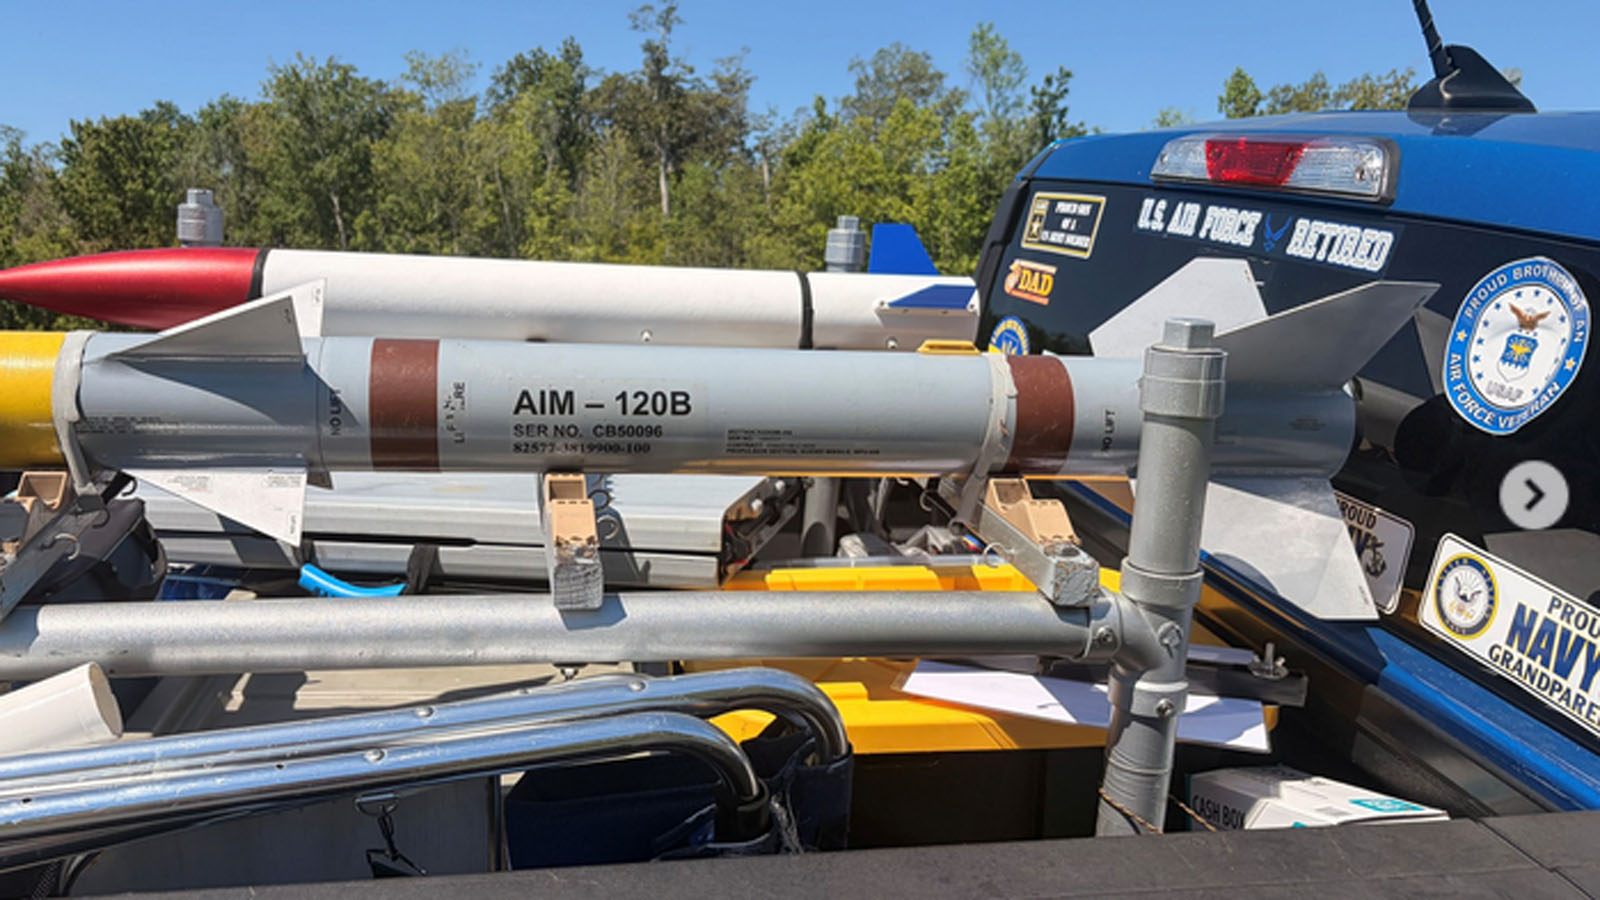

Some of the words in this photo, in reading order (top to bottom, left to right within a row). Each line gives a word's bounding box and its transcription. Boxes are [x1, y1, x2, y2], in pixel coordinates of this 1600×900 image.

[1137, 197, 1168, 231] U.S.
[1167, 201, 1201, 237] AIR
[1199, 205, 1263, 247] FORCE
[1285, 218, 1394, 272] RETIRED
[1018, 269, 1054, 296] DAD
[1464, 274, 1508, 320] PROUD
[1450, 353, 1462, 382] AIR
[513, 389, 575, 416] AIM
[615, 390, 692, 417] 120B
[1453, 382, 1496, 427] FORCE
[329, 417, 342, 436] NO
[513, 423, 548, 438] SER
[553, 424, 583, 438] NO.
[592, 424, 663, 438] CB50096
[1337, 499, 1377, 530] ROUD
[1505, 601, 1600, 694] NAVY
[1488, 643, 1600, 727] GRANDPARE
[1192, 794, 1220, 823] CASH
